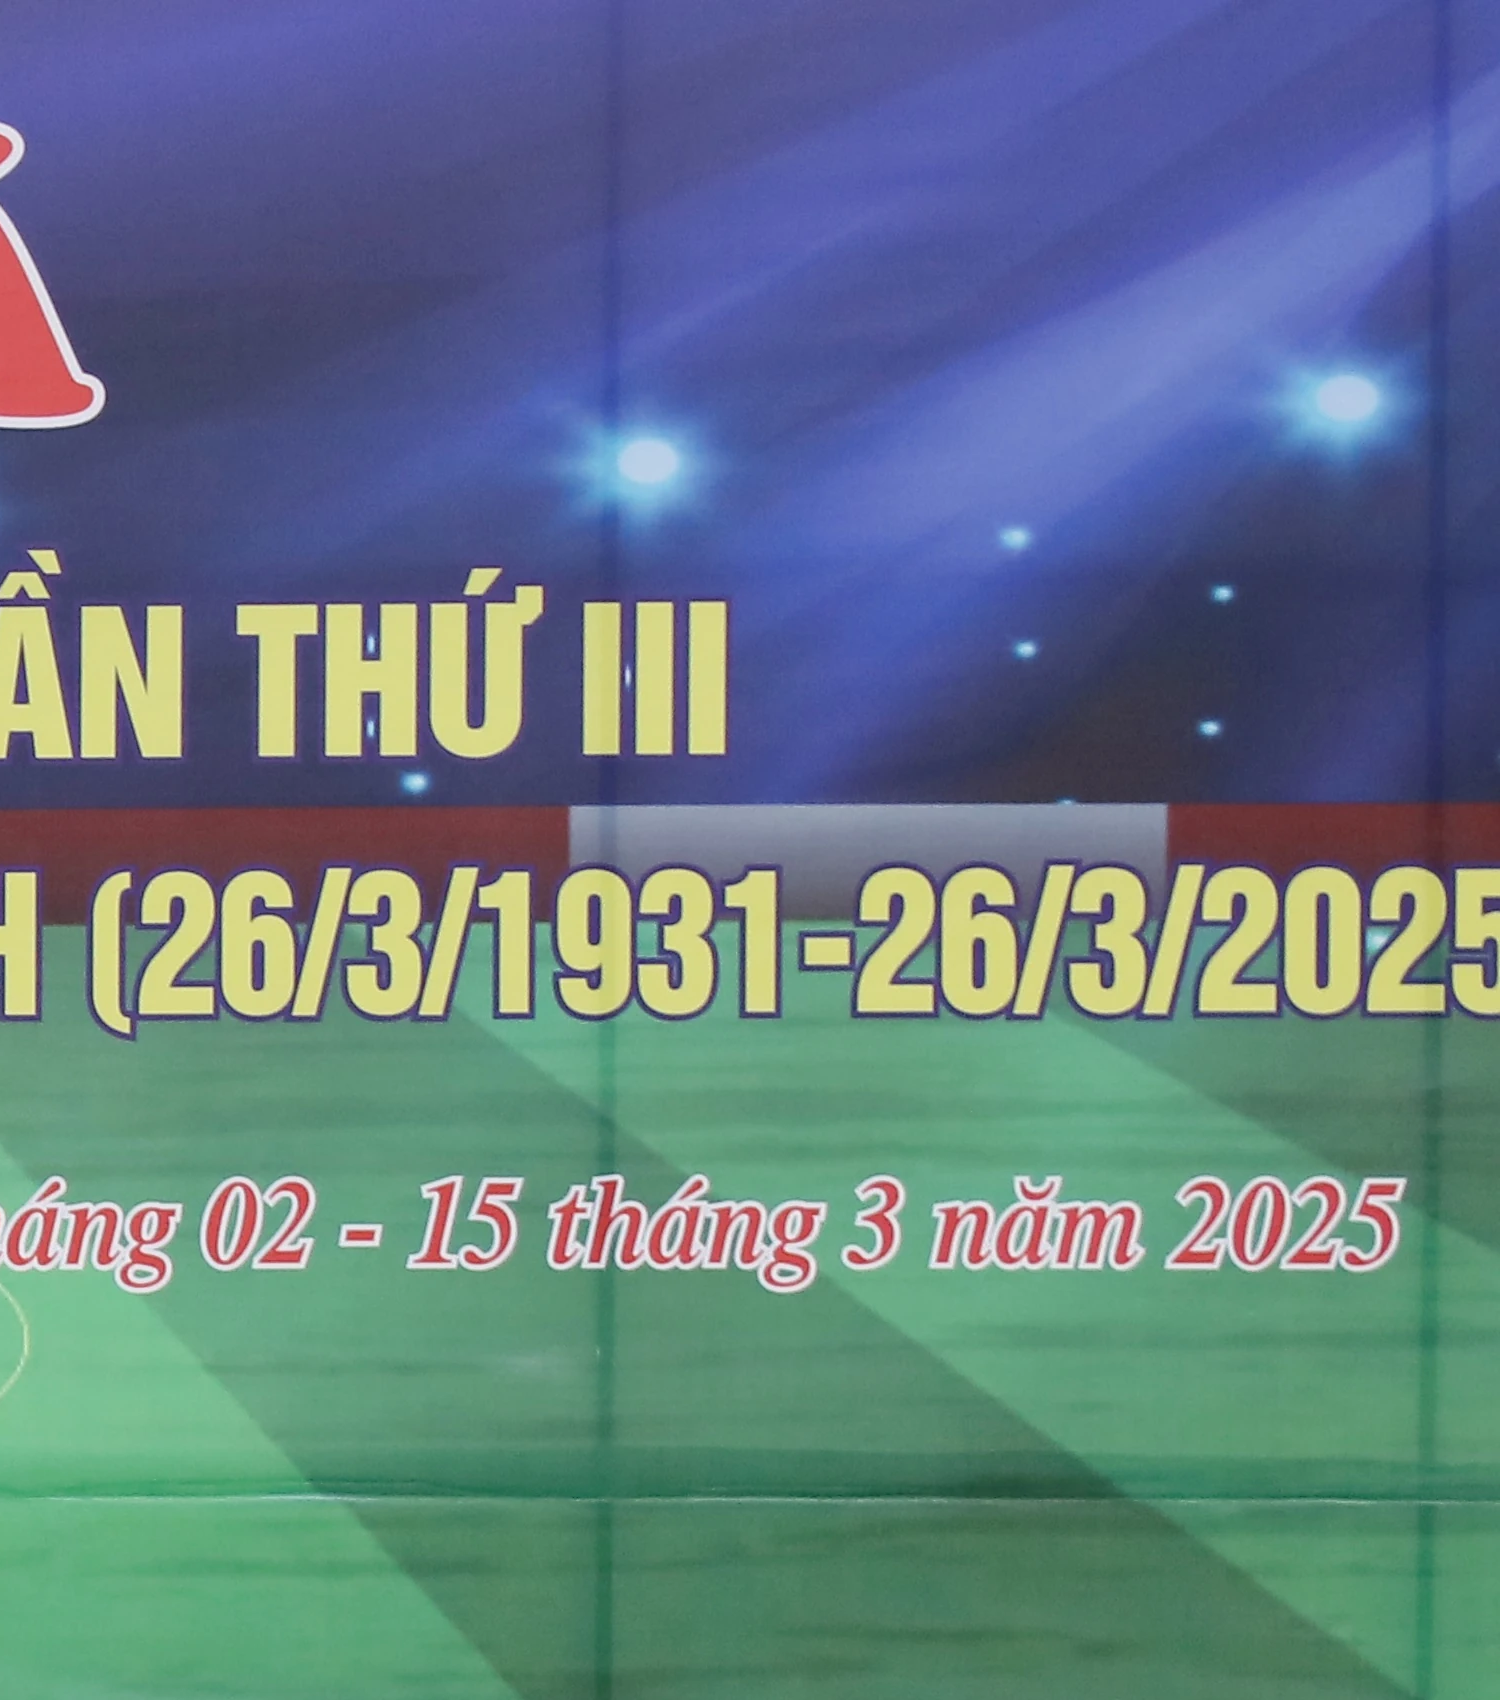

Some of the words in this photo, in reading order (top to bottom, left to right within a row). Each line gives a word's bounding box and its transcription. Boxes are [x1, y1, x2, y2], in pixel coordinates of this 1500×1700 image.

[238, 568, 545, 757] THỨ
[584, 601, 728, 755] III
[204, 1179, 313, 1267] 02
[342, 1226, 380, 1245] -
[417, 1180, 517, 1268] 15
[551, 1178, 822, 1289] tháng
[845, 1178, 902, 1268] 3
[935, 1185, 1138, 1268] năm
[1172, 1179, 1400, 1269] 2025
